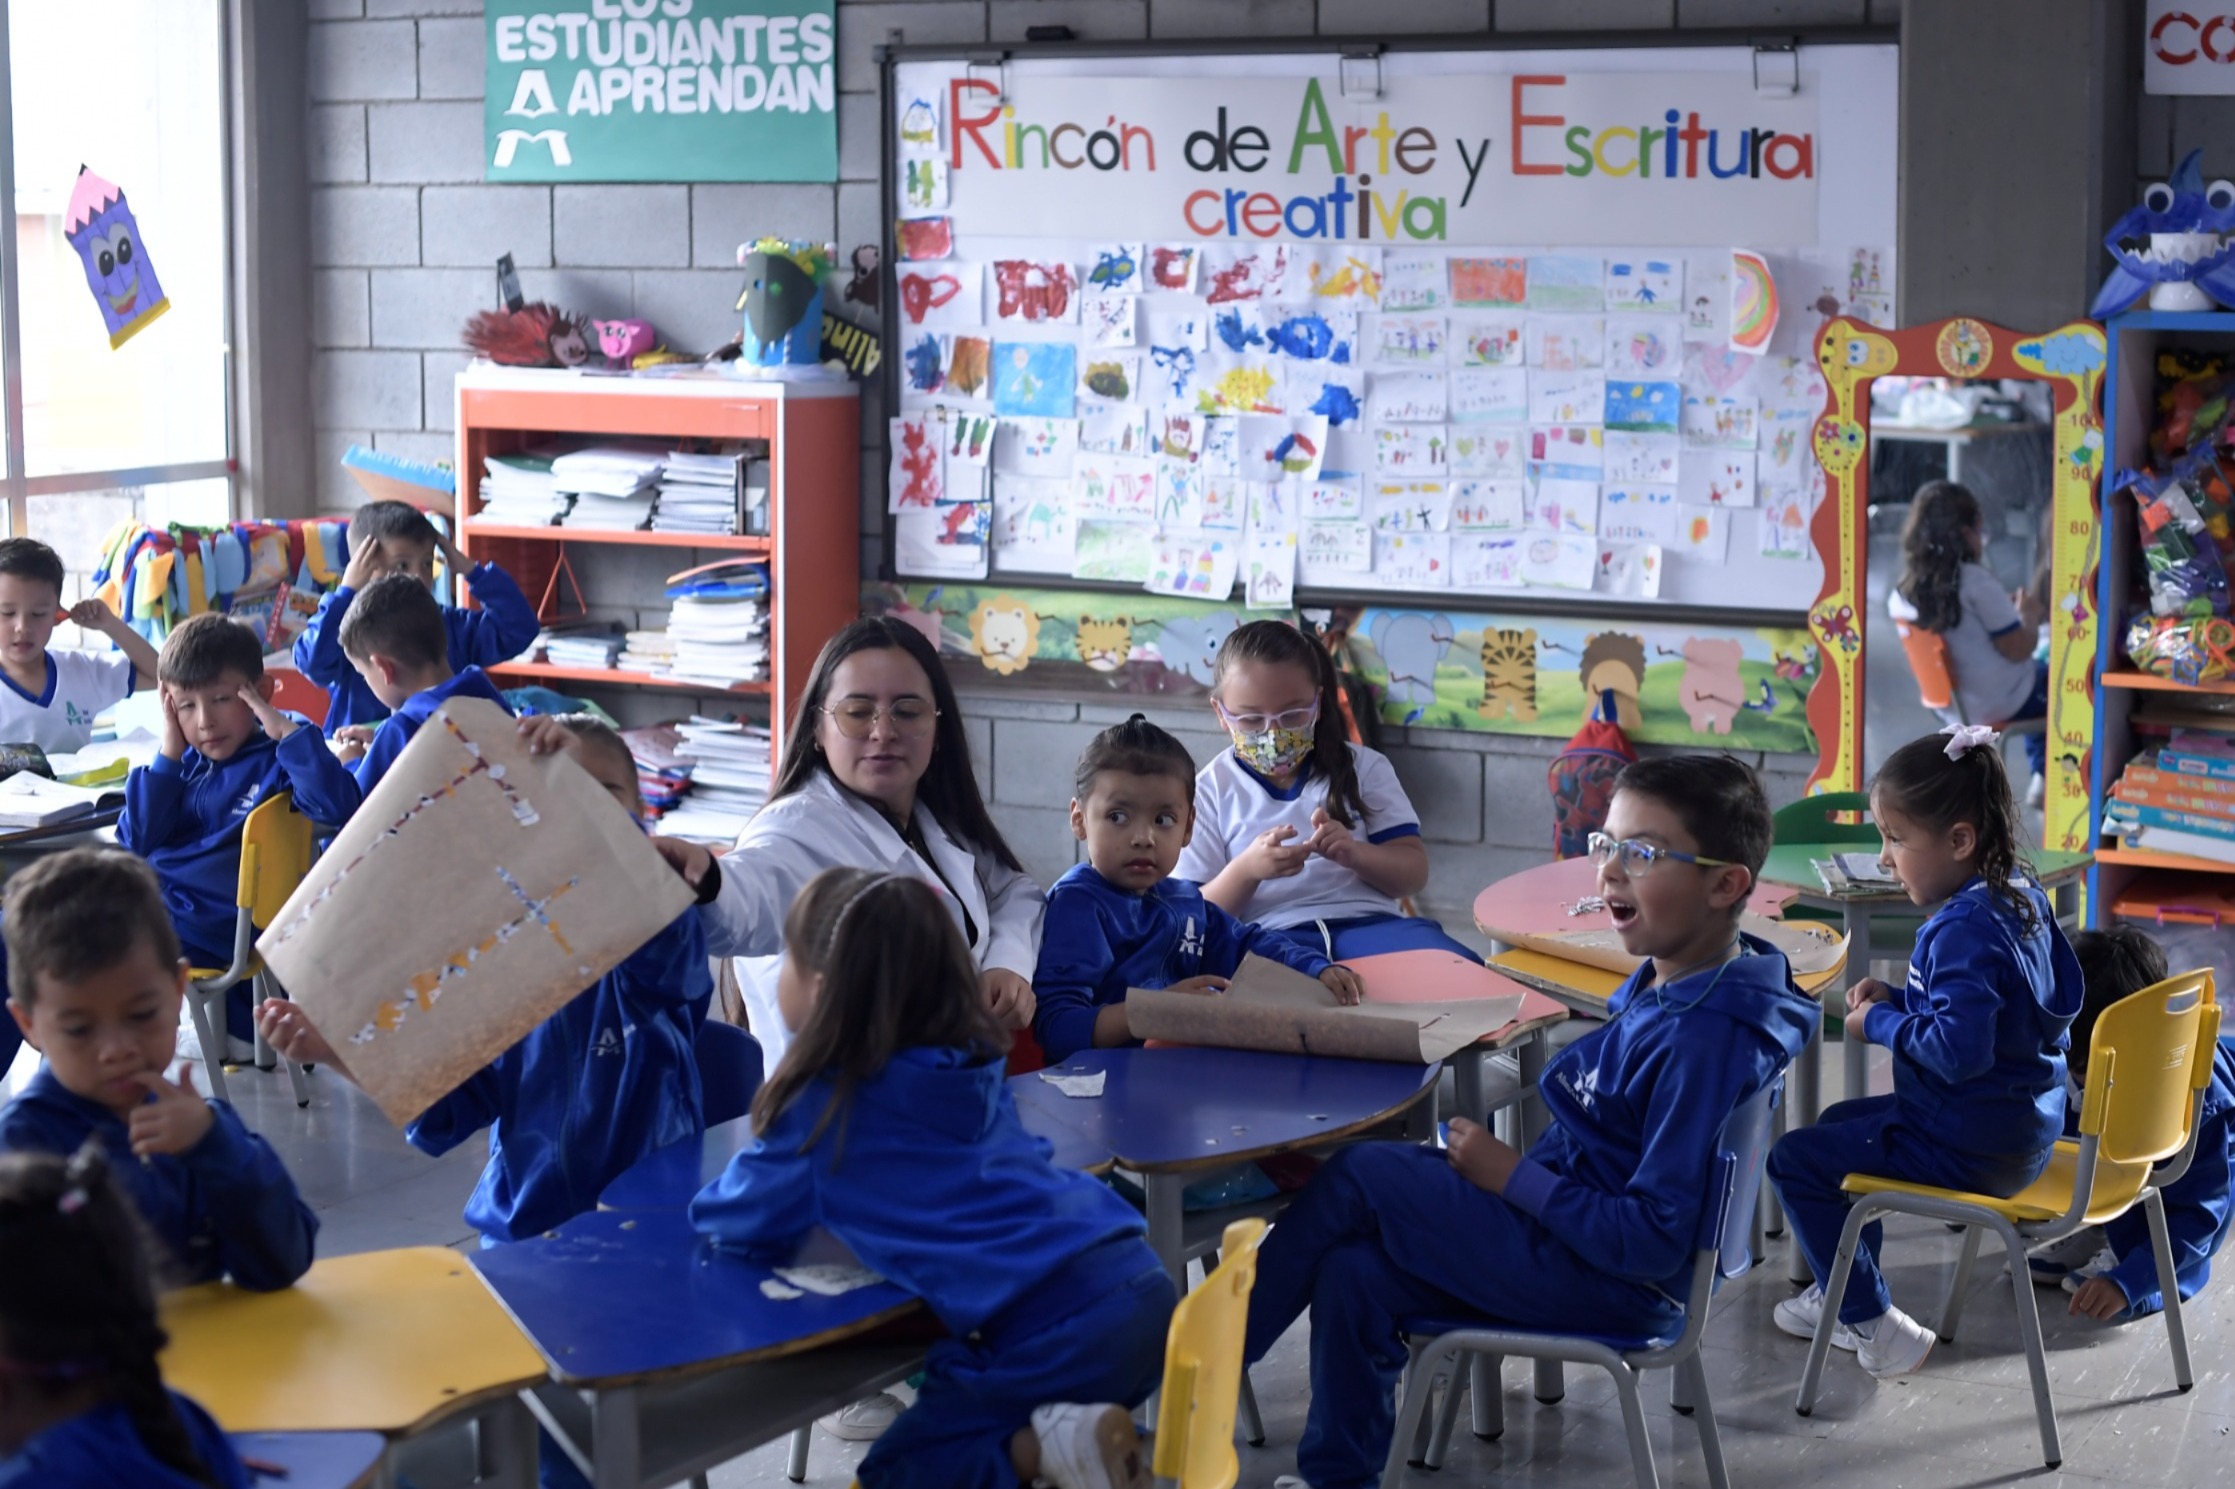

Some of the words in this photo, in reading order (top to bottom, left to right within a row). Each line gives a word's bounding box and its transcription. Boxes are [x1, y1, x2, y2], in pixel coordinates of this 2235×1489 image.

[496, 13, 833, 67] ESTUDIANTES
[567, 63, 835, 117] APRENDAN
[950, 78, 1155, 172] Rincón
[1184, 106, 1270, 172] de
[1287, 77, 1437, 175] Arte
[1456, 138, 1491, 208] y
[1511, 75, 1814, 180] Escritura
[1184, 173, 1446, 240] creativa
[2070, 520, 2089, 535] 80
[2066, 679, 2084, 693] 50
